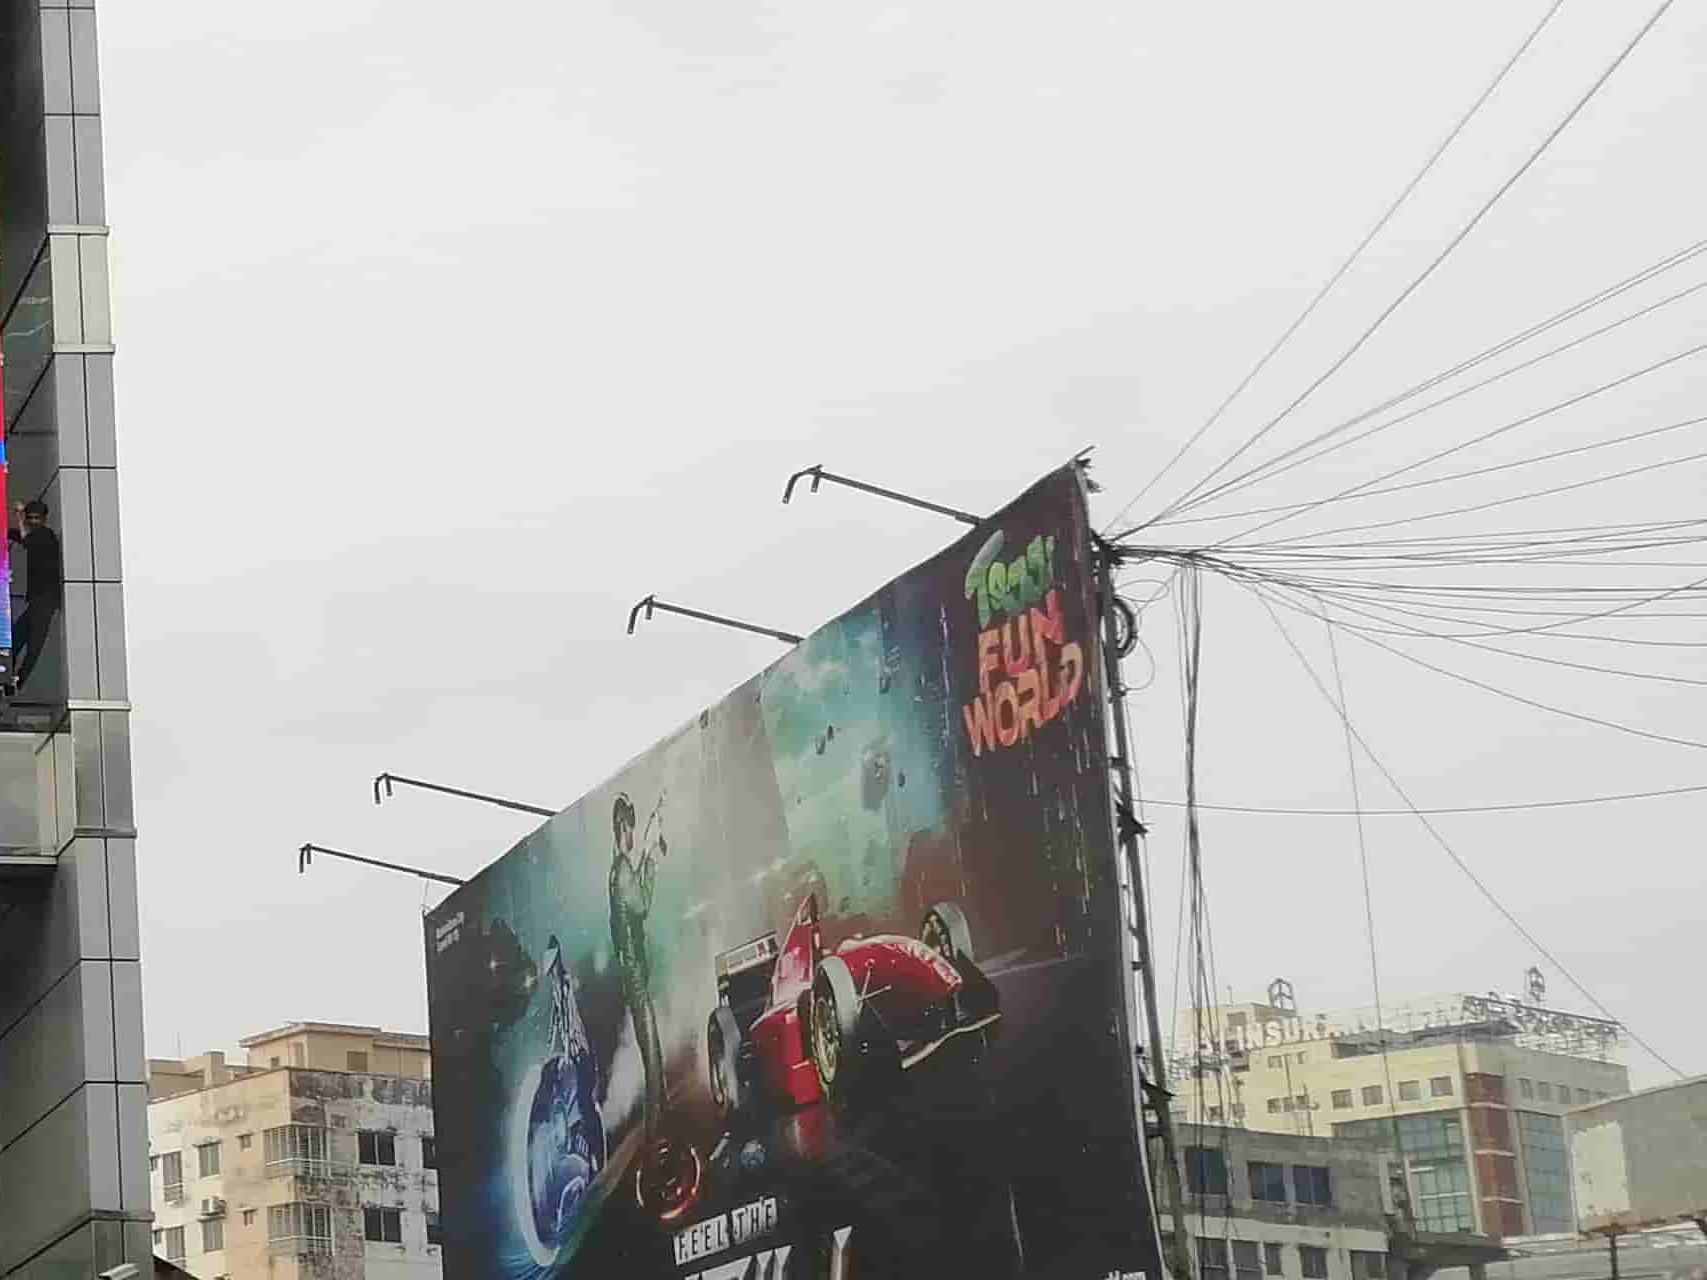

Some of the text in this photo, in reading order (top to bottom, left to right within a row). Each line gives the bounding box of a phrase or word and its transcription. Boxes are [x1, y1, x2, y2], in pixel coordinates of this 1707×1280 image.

[978, 587, 1063, 695] FUN
[962, 641, 1084, 757] WORLD
[673, 1196, 779, 1266] FEEL THE
